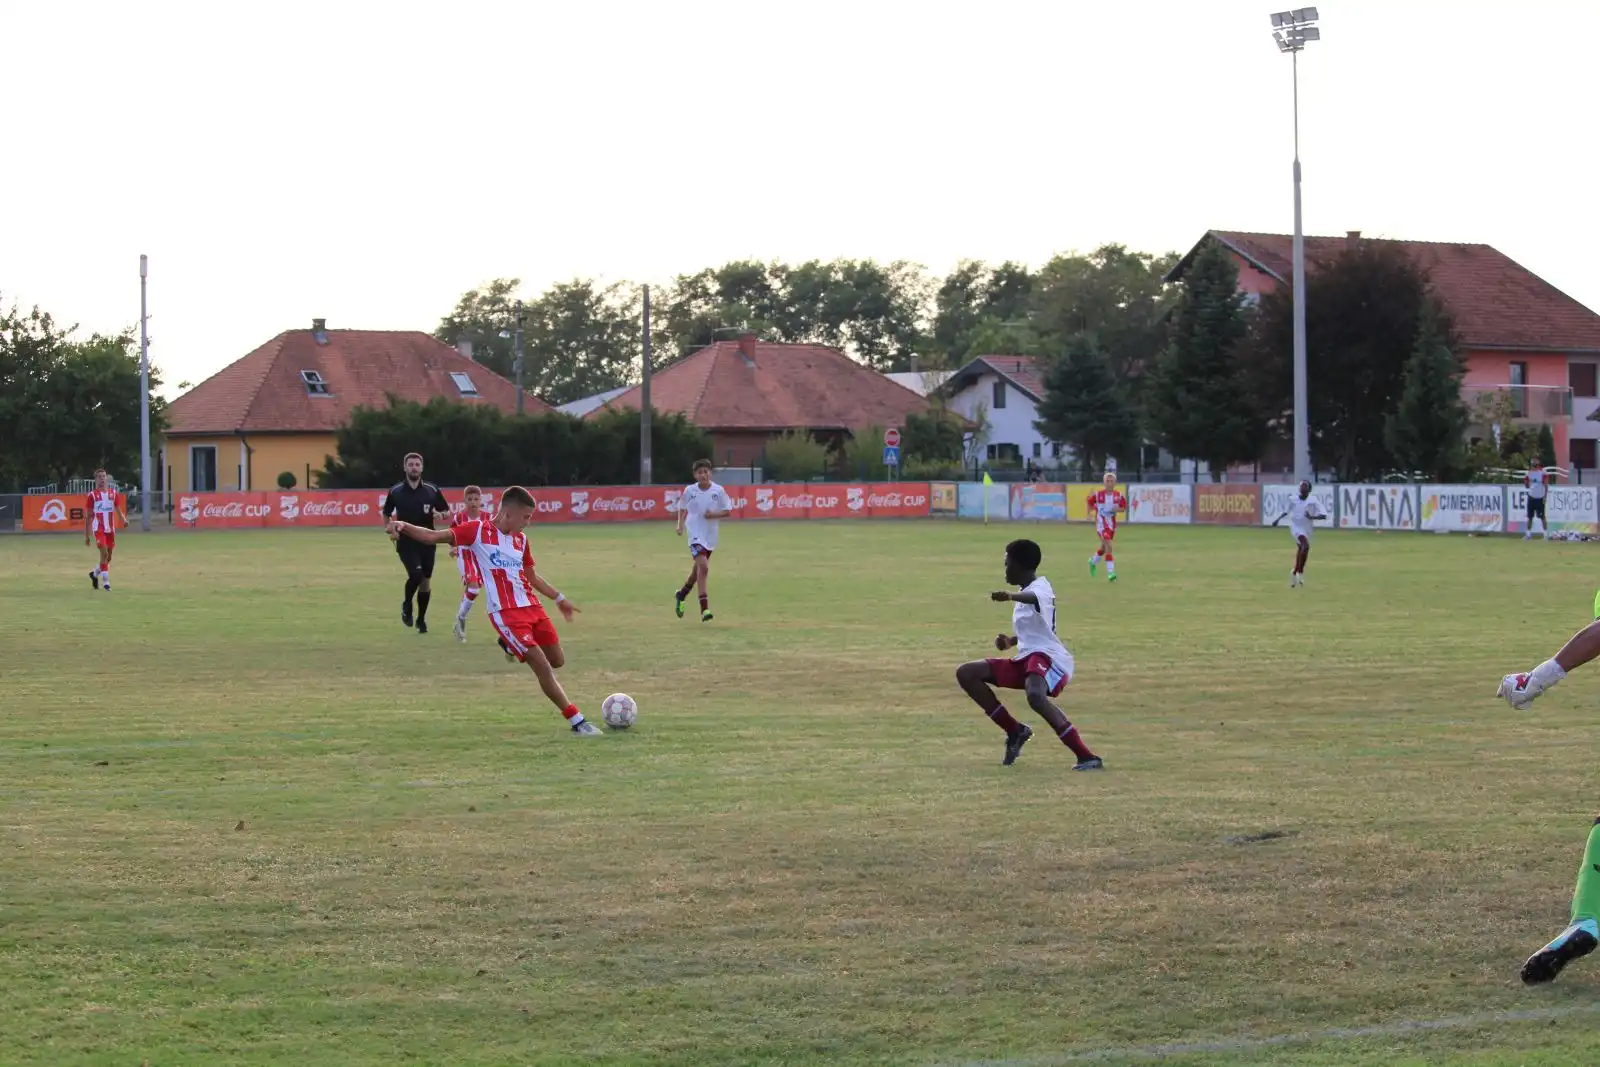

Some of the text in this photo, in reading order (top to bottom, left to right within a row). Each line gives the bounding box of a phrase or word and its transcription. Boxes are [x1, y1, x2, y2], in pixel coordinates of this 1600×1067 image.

[538, 500, 563, 513] CUP
[592, 497, 656, 512] Coca-Cola CUP
[729, 497, 748, 508] UP
[815, 497, 839, 508] CUP
[903, 495, 925, 506] CUP
[1440, 494, 1500, 512] CIMERMAN
[203, 502, 271, 517] Coca-Cola CUP
[303, 501, 369, 516] Coca-Cola CUP
[449, 502, 466, 513] UP
